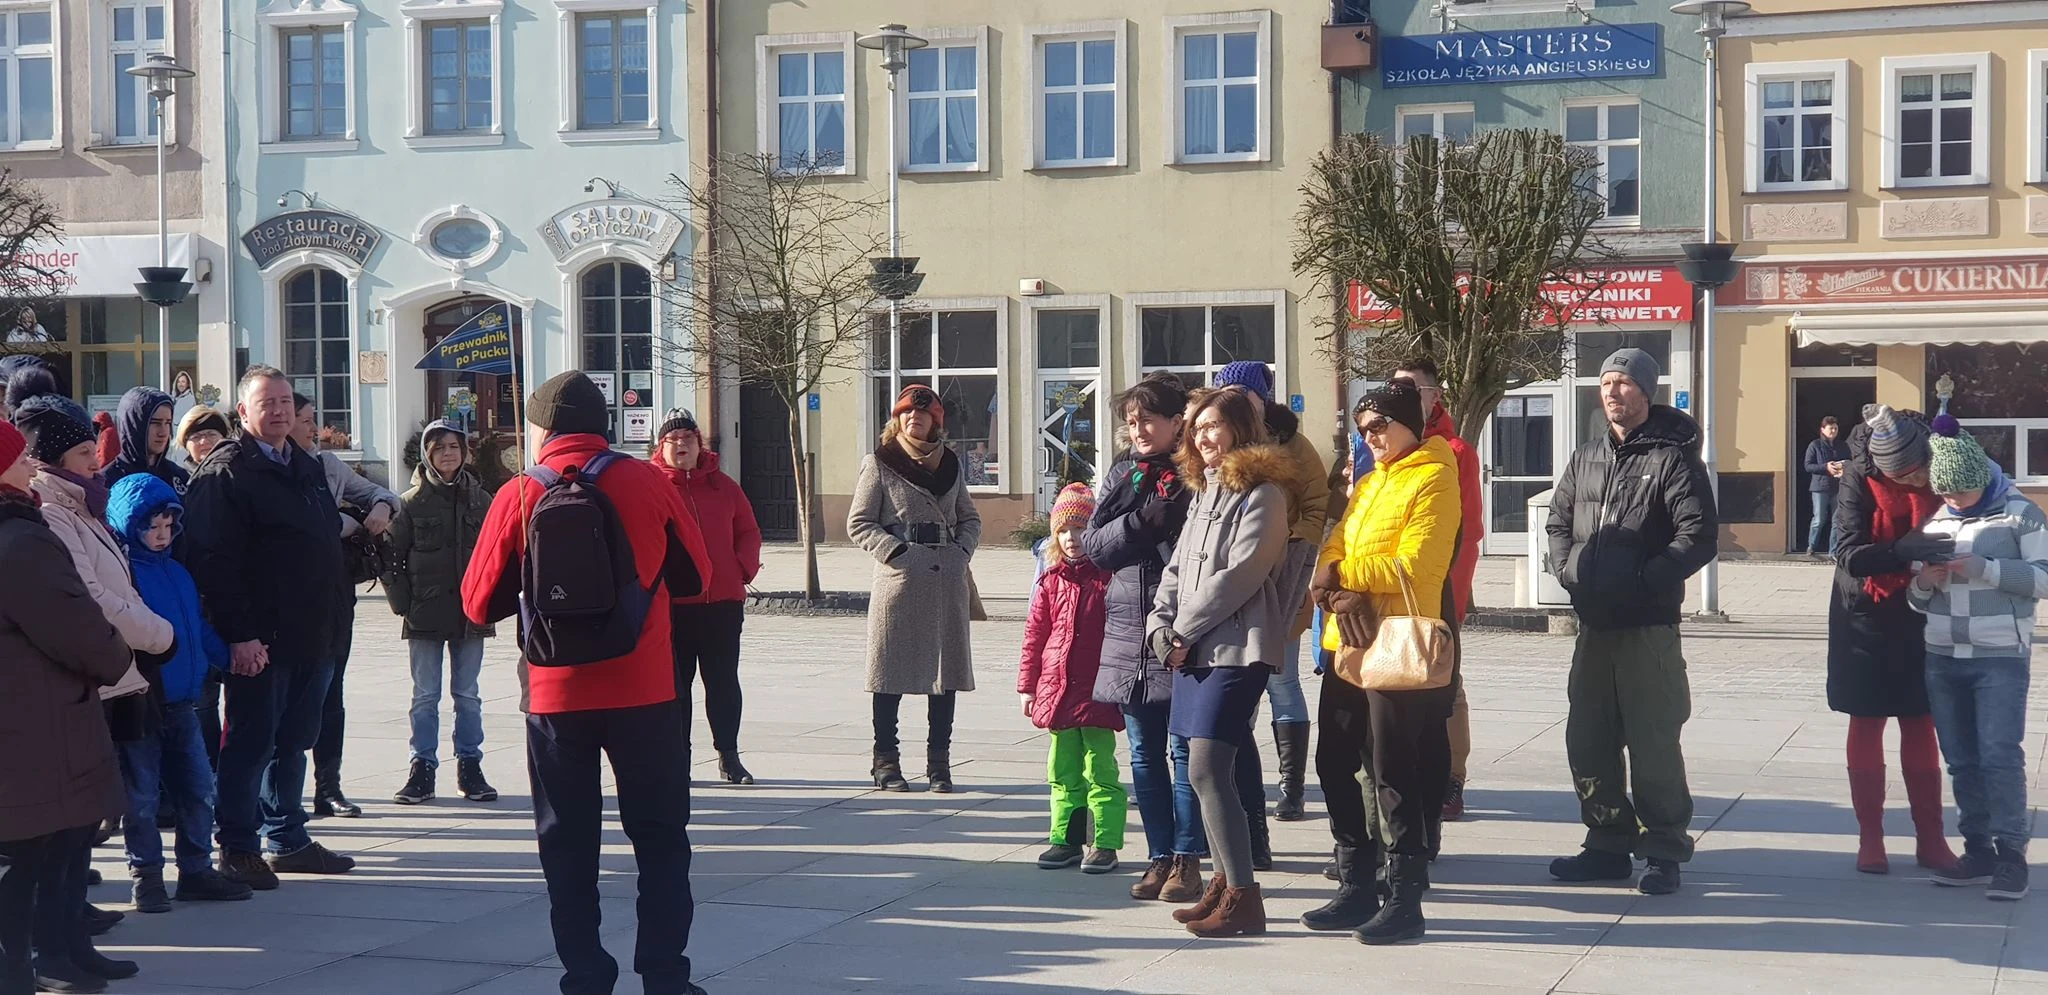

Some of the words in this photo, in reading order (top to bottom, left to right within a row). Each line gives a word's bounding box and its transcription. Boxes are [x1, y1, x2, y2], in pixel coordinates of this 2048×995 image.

[1435, 30, 1612, 60] MASTERS
[1386, 68, 1450, 82] SZKOŁA
[1456, 63, 1520, 80] JĘZYKA
[1524, 59, 1650, 75] ANGIELSKIEGO
[571, 206, 652, 227] SALON
[252, 218, 367, 247] Restauracja
[570, 221, 655, 243] OPTYCZNY
[262, 242, 280, 258] Pod
[283, 235, 323, 248] Złotym
[326, 235, 359, 257] Lwem
[441, 330, 508, 357] Przewodnik
[456, 354, 469, 368] po
[472, 346, 508, 361] Pucku
